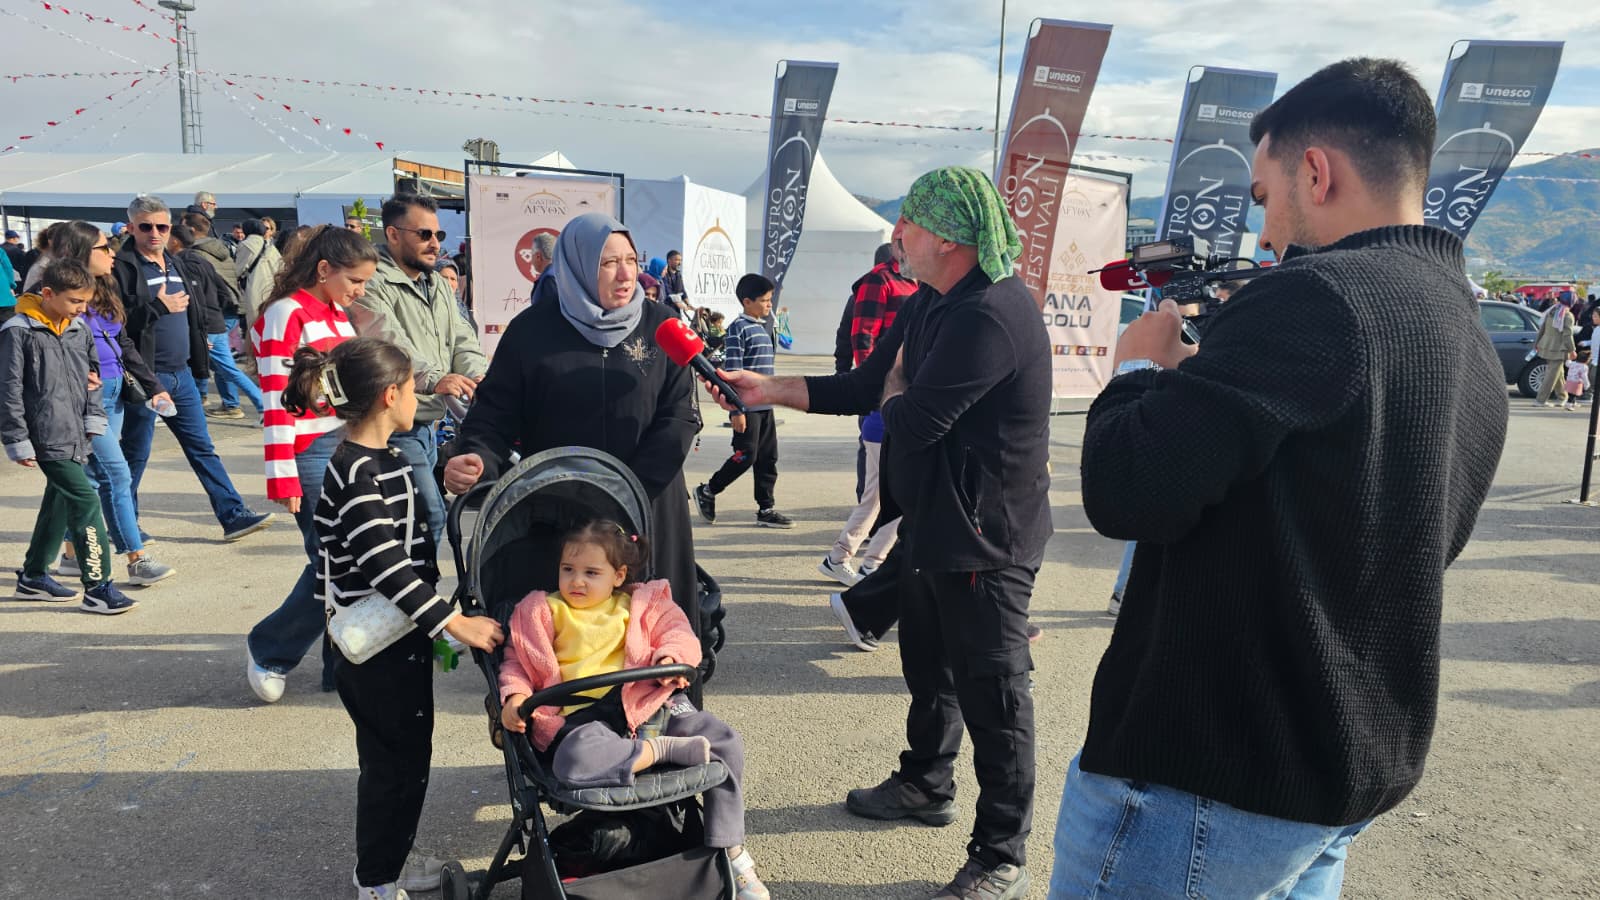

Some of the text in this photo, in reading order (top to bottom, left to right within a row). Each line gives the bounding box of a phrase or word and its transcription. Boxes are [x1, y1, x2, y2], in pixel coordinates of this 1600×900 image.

[1048, 71, 1081, 83] unesco
[1485, 87, 1532, 98] unesco
[1218, 108, 1254, 119] unesco
[524, 205, 567, 216] AFYON
[1166, 195, 1190, 240] TRO
[1026, 175, 1059, 290] FESTİVALİ
[1213, 195, 1244, 258] TİVALİ
[700, 252, 732, 271] GASTRO
[695, 271, 737, 295] AFYON
[85, 525, 103, 581] Collegian
